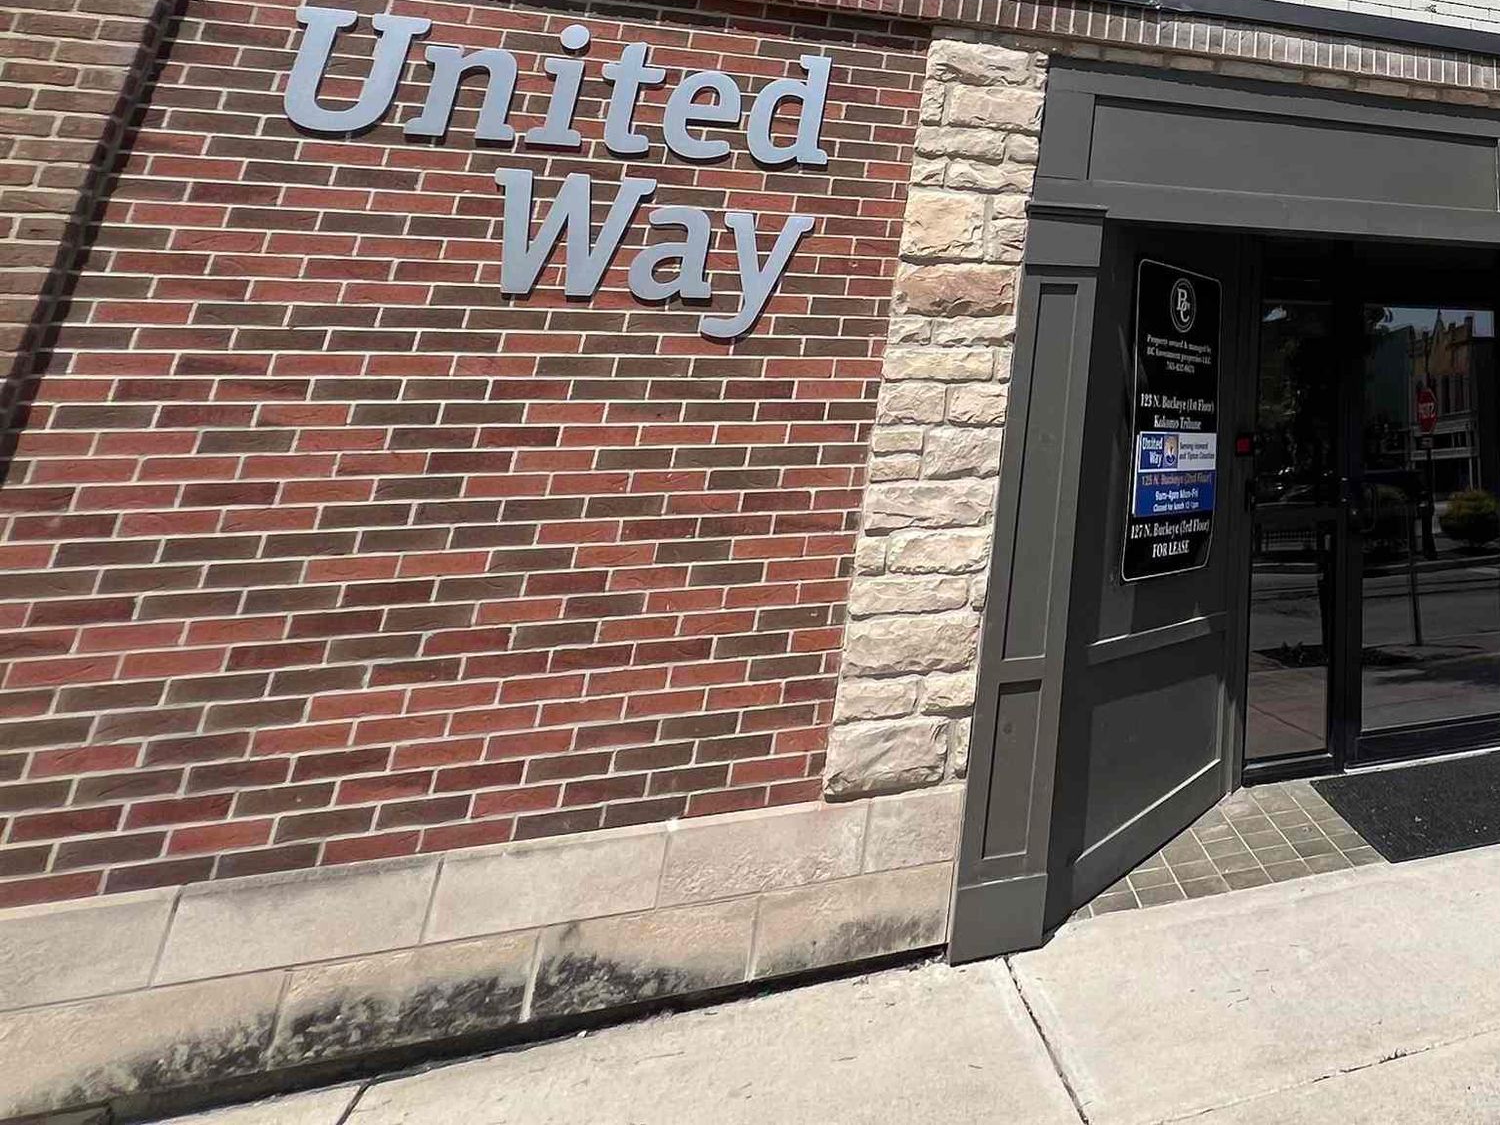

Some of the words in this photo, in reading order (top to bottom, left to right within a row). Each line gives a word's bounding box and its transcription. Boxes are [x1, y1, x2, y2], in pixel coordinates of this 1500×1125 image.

[283, 6, 831, 165] United
[494, 168, 815, 339] Way
[1140, 393, 1152, 407] 123
[1162, 395, 1186, 413] Buckeye
[1198, 398, 1215, 414] Floor)
[1154, 415, 1180, 429] Kokomo
[1180, 416, 1202, 430] Tribune
[1142, 437, 1163, 450] United
[1149, 451, 1162, 468] Way
[1180, 488, 1199, 499] Mon-Fri
[1153, 503, 1167, 512] Closed
[1131, 524, 1143, 540] 127
[1143, 523, 1152, 538] N.
[1153, 522, 1179, 539] Buckeye
[1180, 519, 1193, 536] (3rd
[1193, 518, 1210, 533] Floor)
[1152, 543, 1168, 558] FOR
[1168, 539, 1190, 555] LEASE
